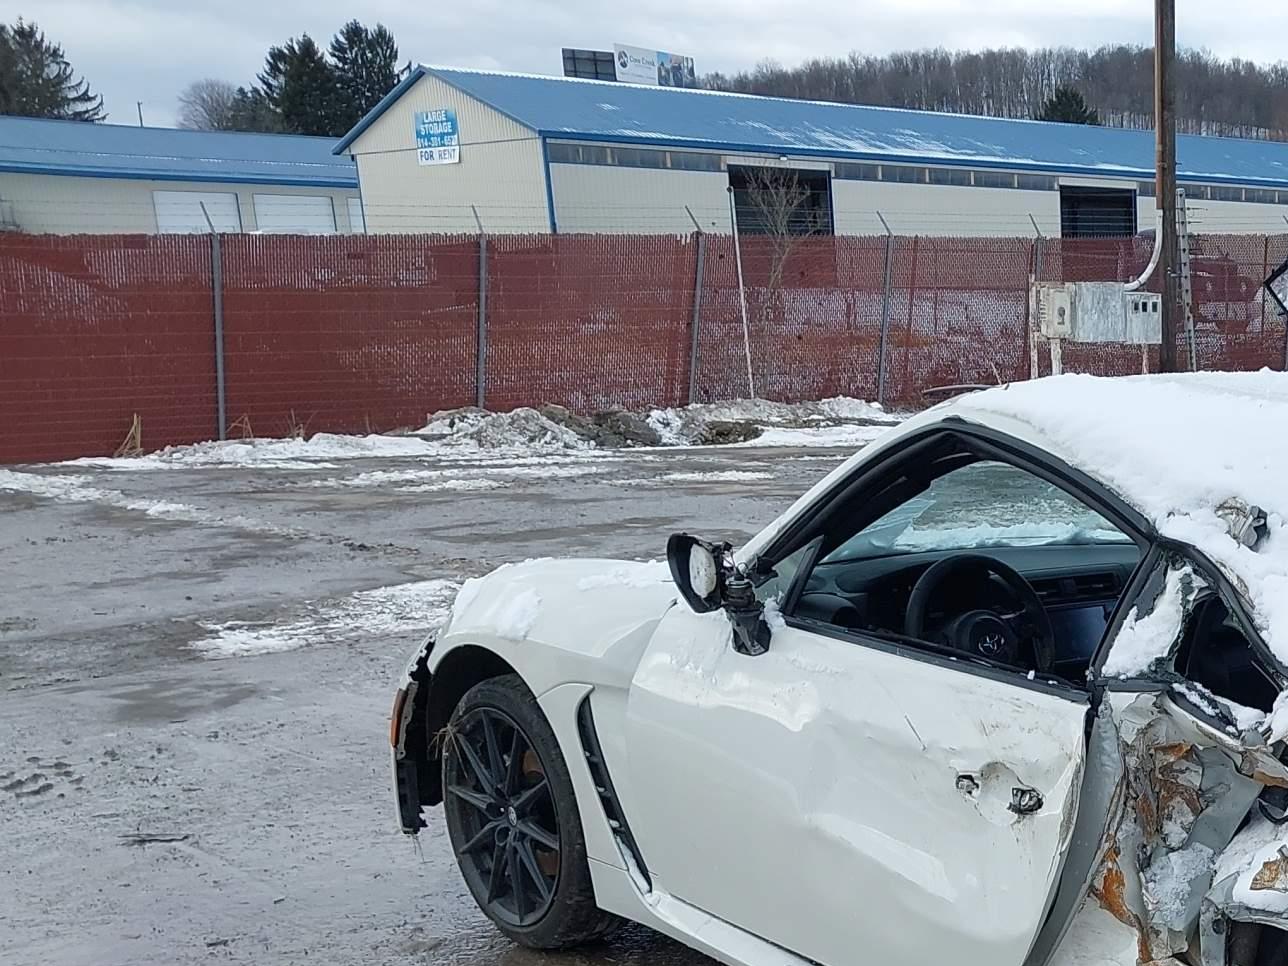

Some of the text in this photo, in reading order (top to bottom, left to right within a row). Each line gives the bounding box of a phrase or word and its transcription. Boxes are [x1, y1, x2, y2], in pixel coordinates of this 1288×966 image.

[424, 110, 447, 123] LARGE
[420, 121, 453, 135] STORAGE
[420, 148, 456, 161] FOR RENT
